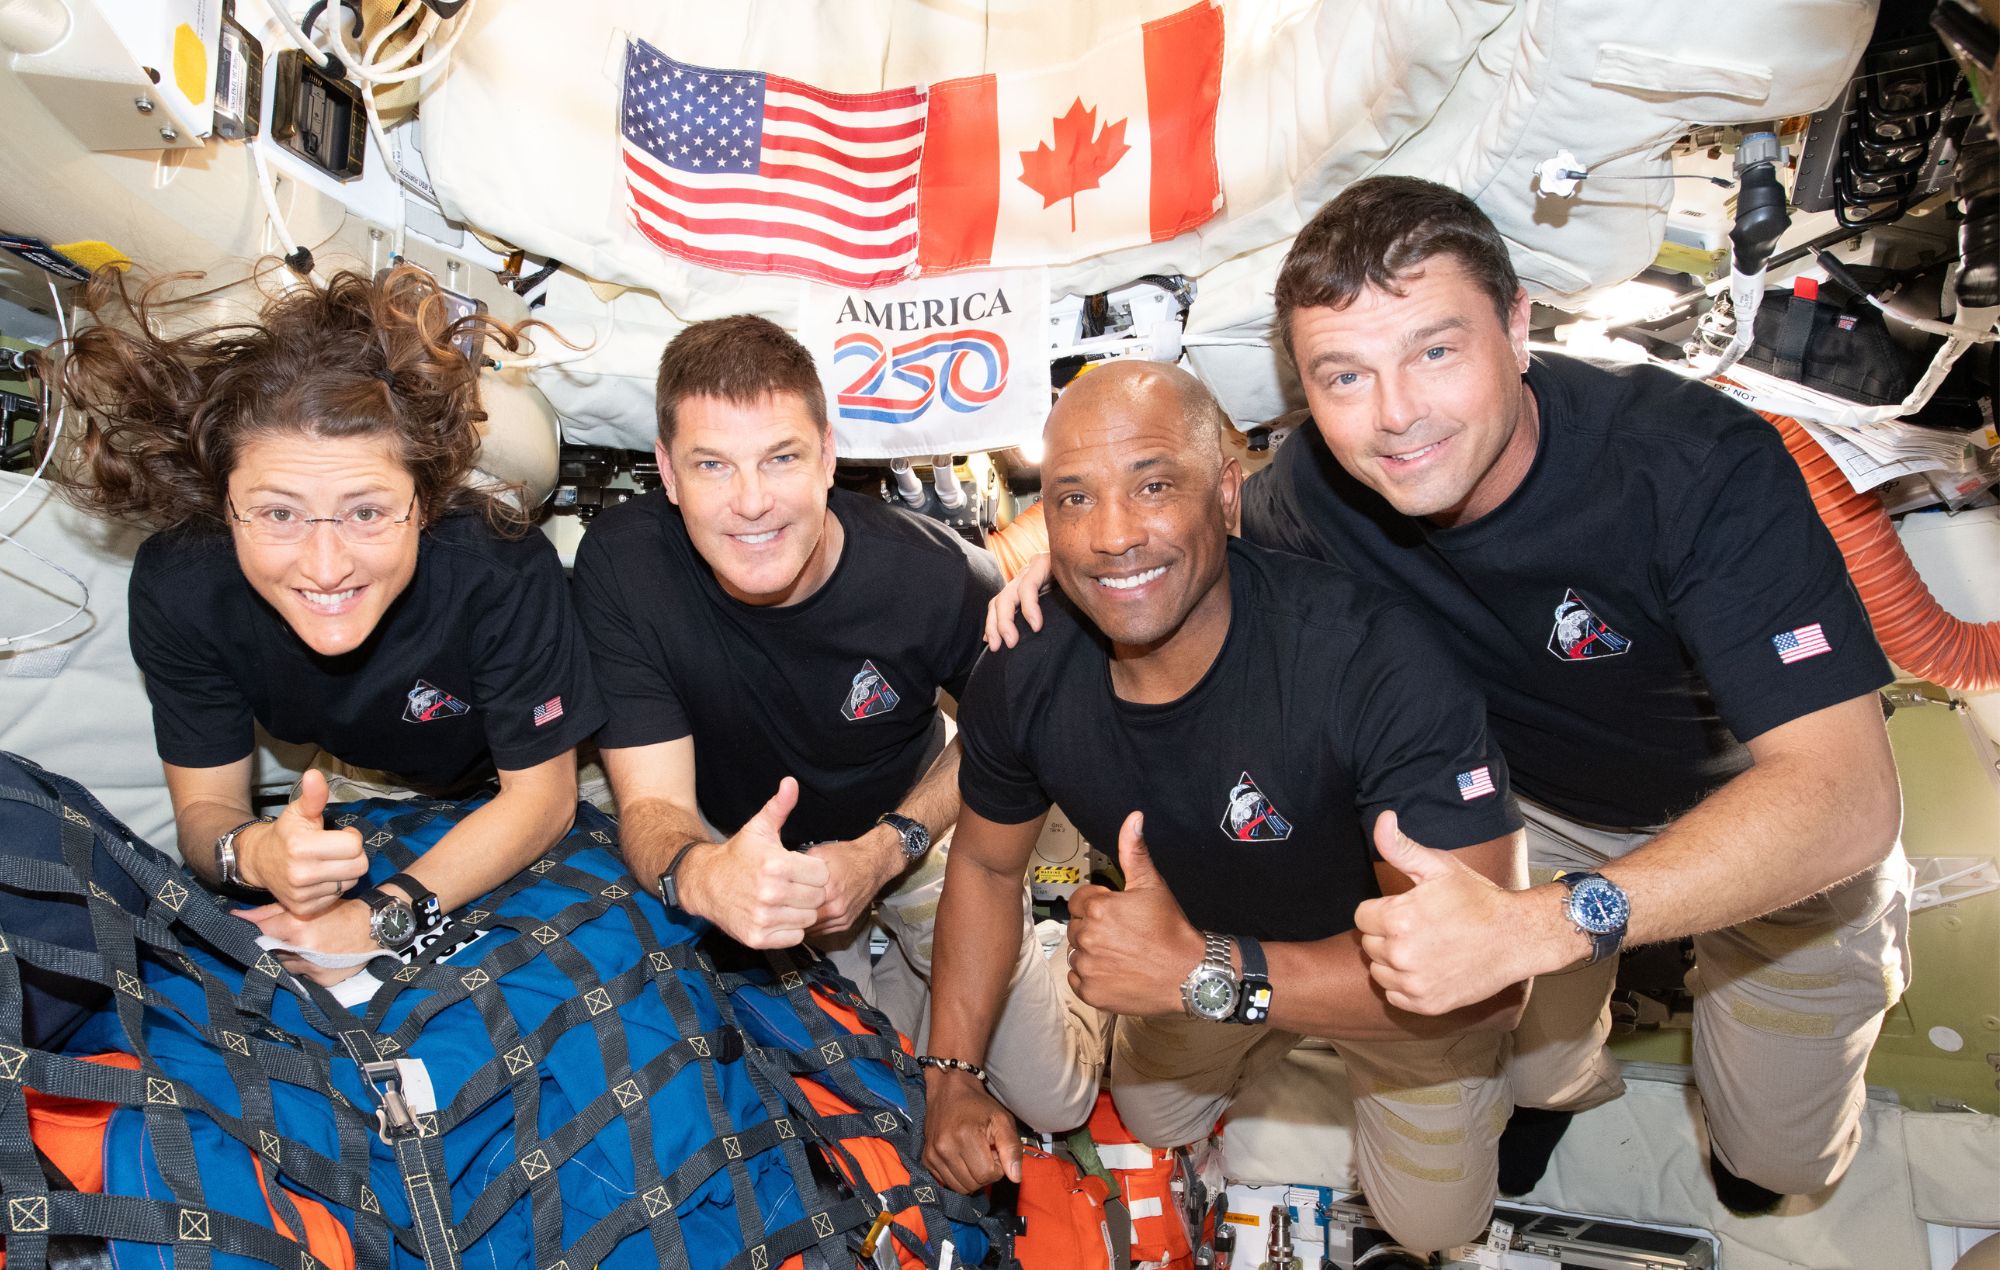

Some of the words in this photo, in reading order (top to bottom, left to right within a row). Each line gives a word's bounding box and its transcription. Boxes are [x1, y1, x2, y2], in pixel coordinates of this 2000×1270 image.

[419, 180, 429, 191] USB
[835, 287, 1013, 331] AMERICA
[833, 329, 1010, 424] 250
[1732, 389, 1758, 402] NOT
[1495, 1225, 1509, 1234] 84
